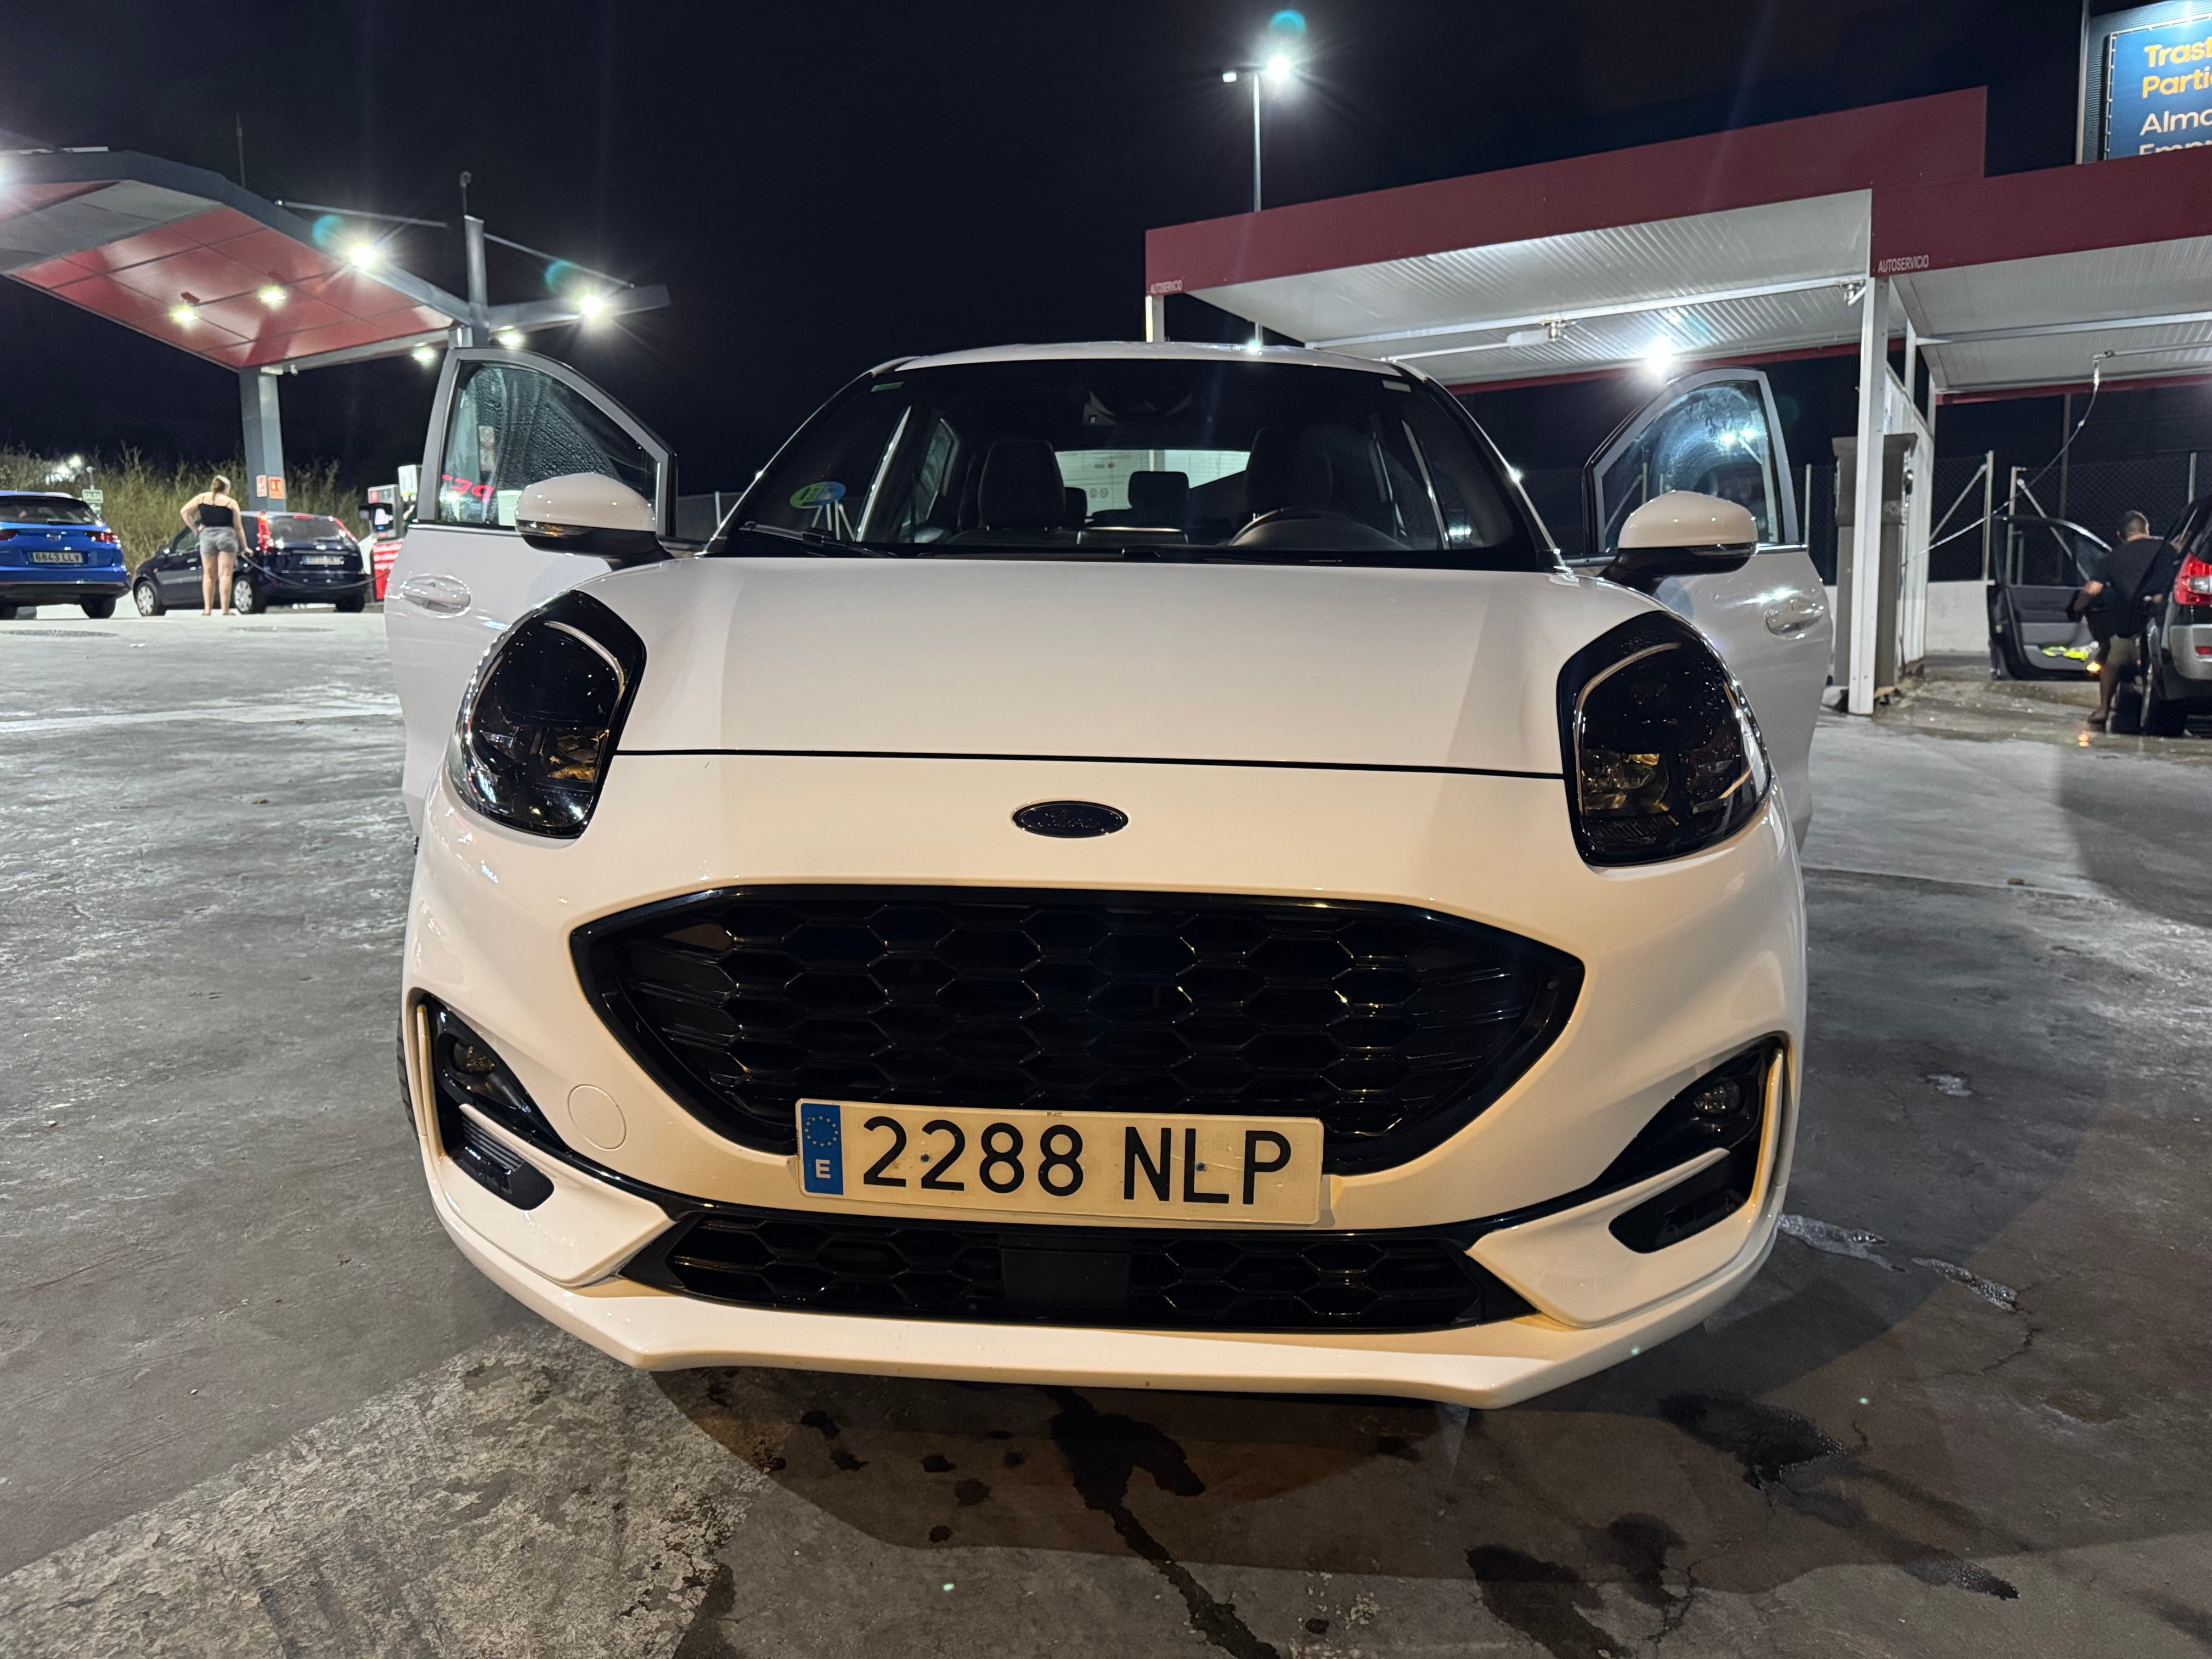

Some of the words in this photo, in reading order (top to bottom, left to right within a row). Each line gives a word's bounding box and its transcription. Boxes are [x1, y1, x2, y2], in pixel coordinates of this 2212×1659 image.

[2142, 66, 2212, 98] Parti
[1878, 255, 1929, 273] AUTOSERVICIO
[815, 1159, 831, 1178] E
[864, 1116, 1083, 1196] 2288
[1124, 1127, 1291, 1204] NLP
